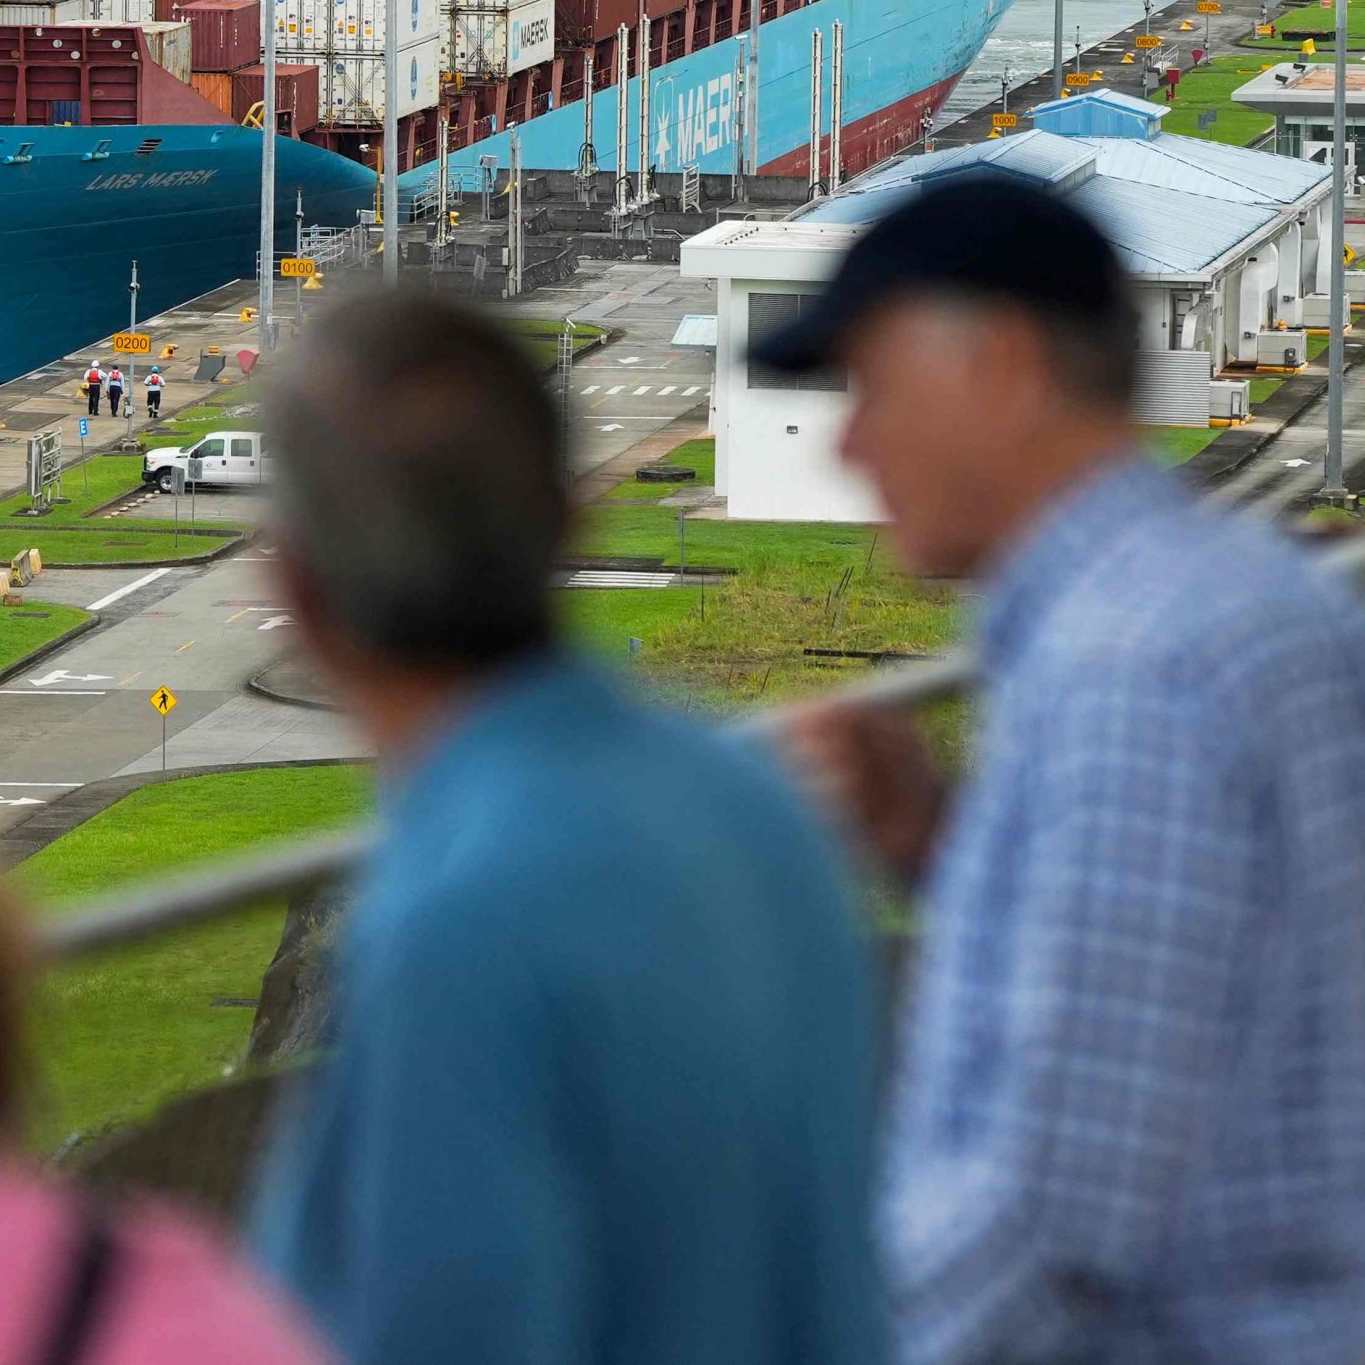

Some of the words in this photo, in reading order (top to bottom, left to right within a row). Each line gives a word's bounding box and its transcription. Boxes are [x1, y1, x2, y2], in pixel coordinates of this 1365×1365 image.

[520, 17, 549, 48] MAERSK
[1067, 75, 1088, 84] 0900
[85, 173, 144, 191] LARS
[141, 169, 220, 188] MÆRSK
[283, 261, 313, 274] 0100
[115, 337, 148, 350] 0200
[80, 421, 86, 434] E
